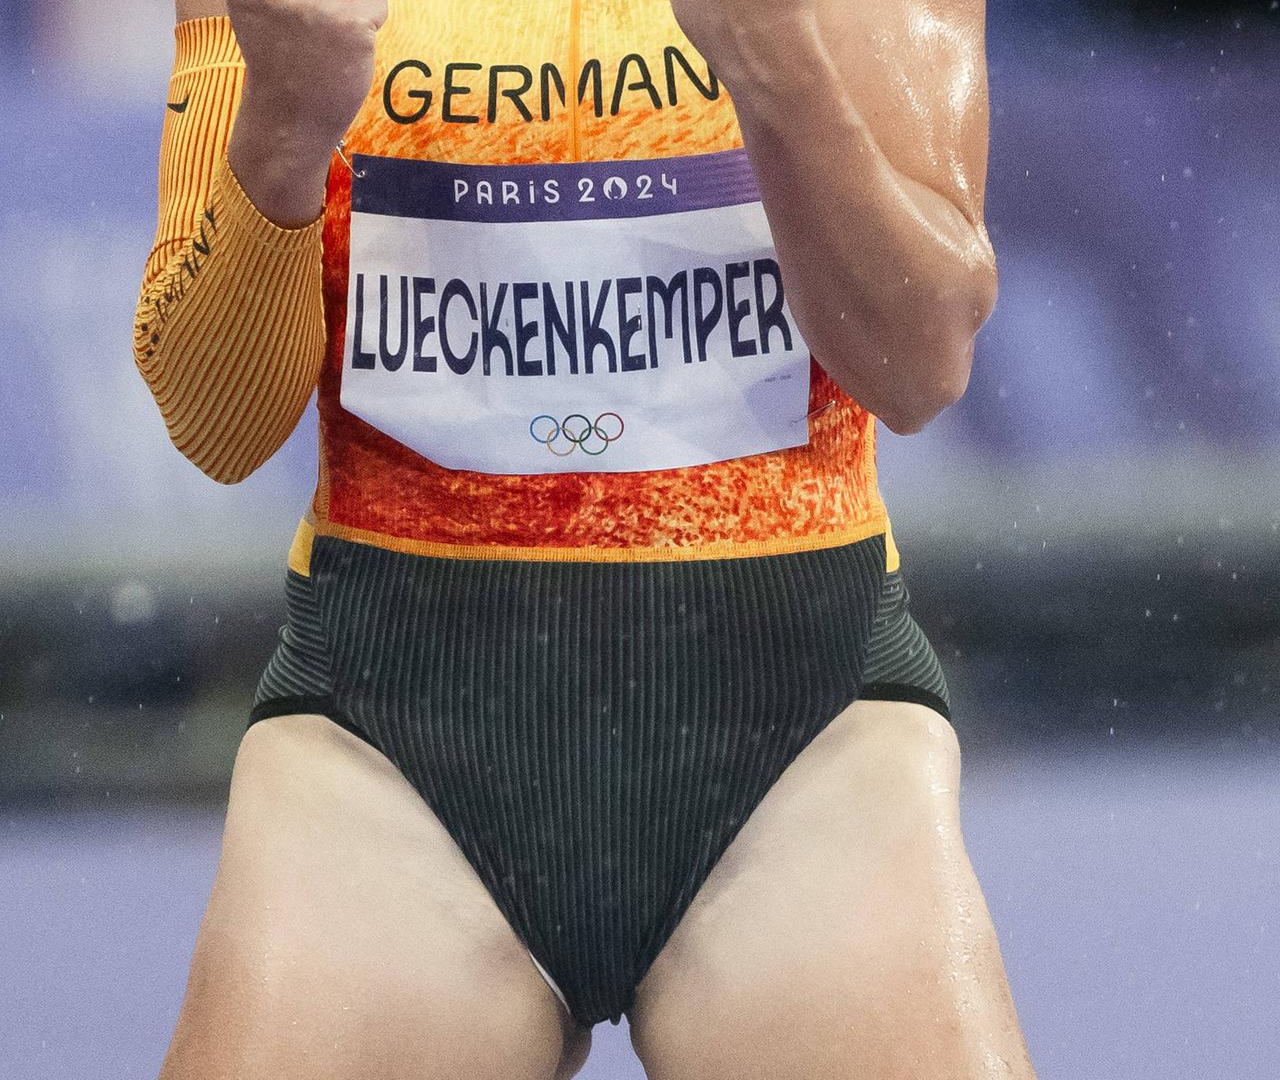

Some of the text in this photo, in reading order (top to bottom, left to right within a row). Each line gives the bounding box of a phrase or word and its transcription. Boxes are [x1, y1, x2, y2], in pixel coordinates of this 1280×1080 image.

[383, 46, 720, 124] GERMAN
[578, 173, 678, 202] 2024
[351, 258, 793, 376] LUECKENKEMPER
